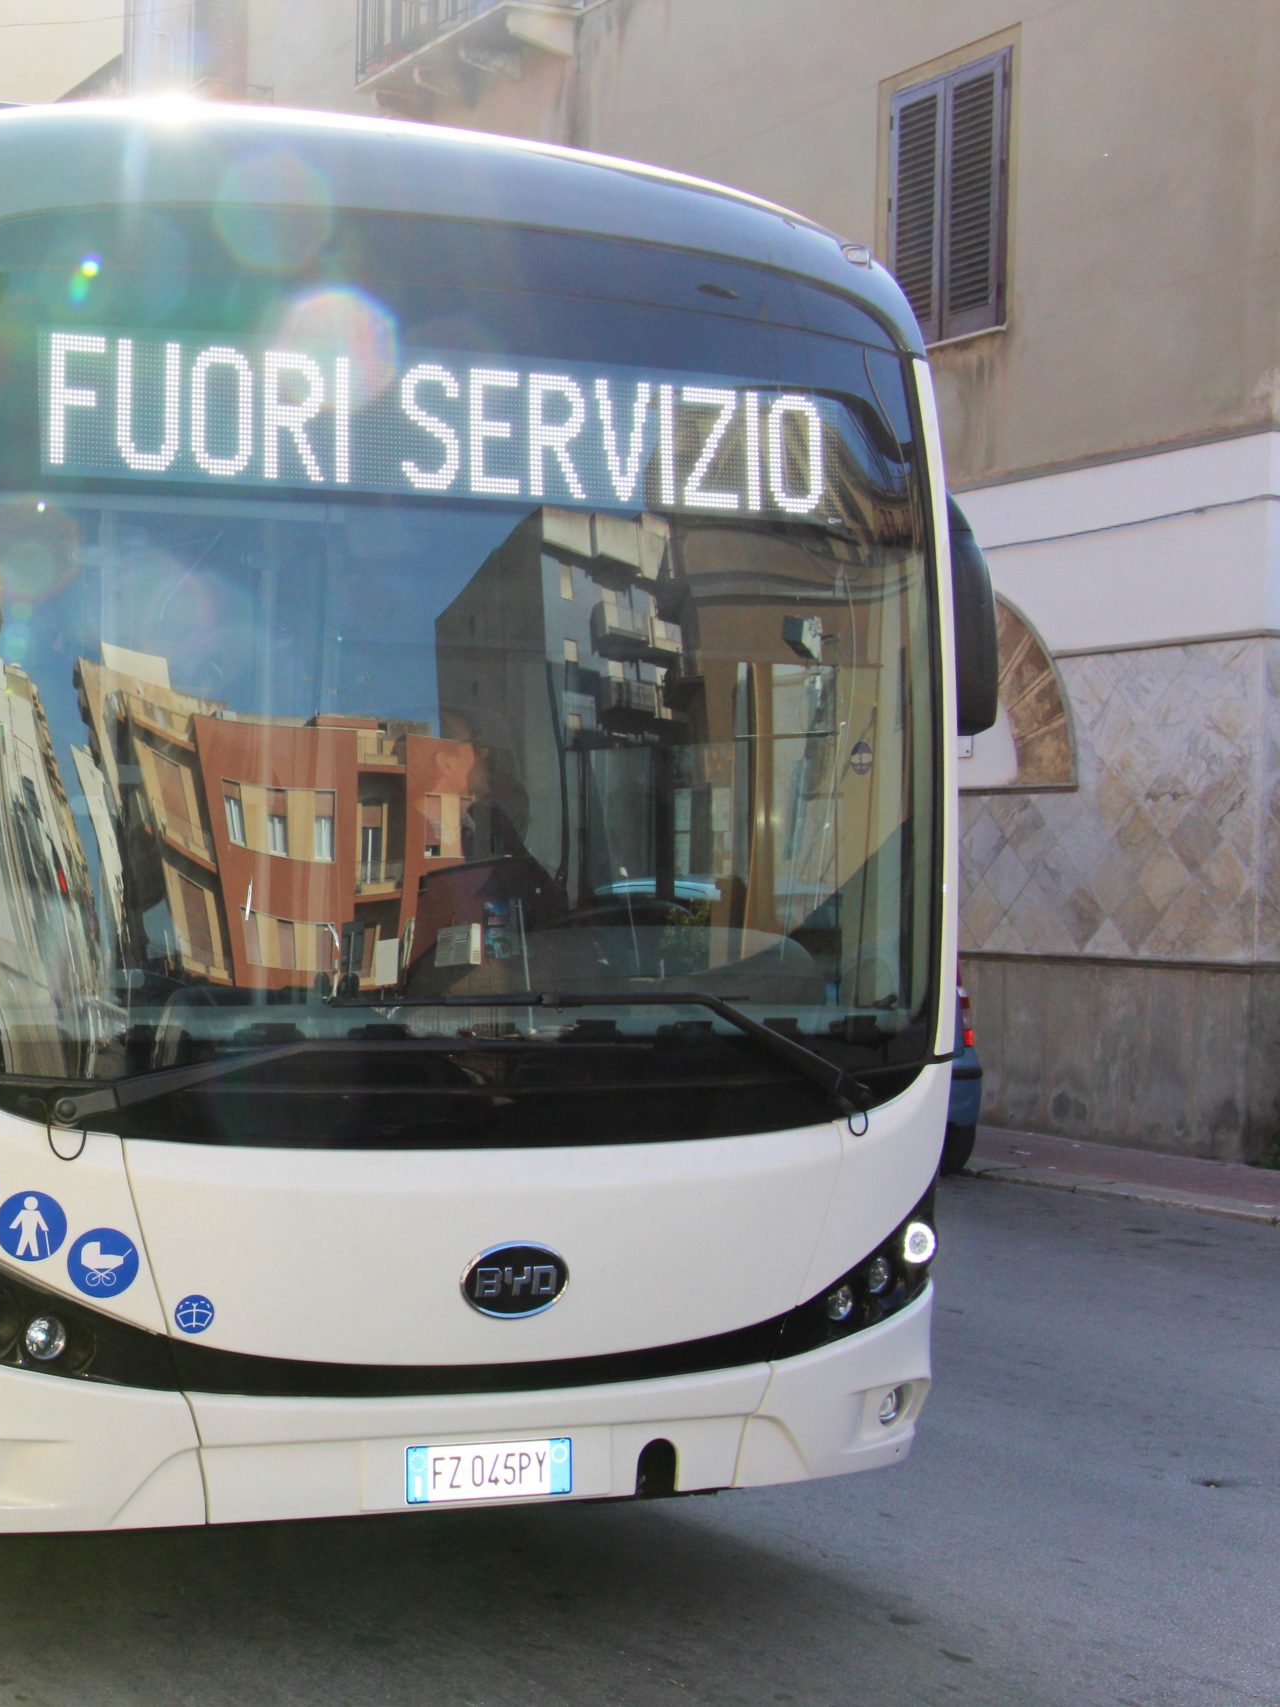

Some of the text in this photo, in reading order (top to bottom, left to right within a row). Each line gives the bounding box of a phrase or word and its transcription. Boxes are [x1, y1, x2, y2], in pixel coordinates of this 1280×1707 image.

[48, 332, 823, 513] FUORI SERVIZIO
[474, 1264, 558, 1298] BYD
[432, 1451, 547, 1490] FZ 045PY
